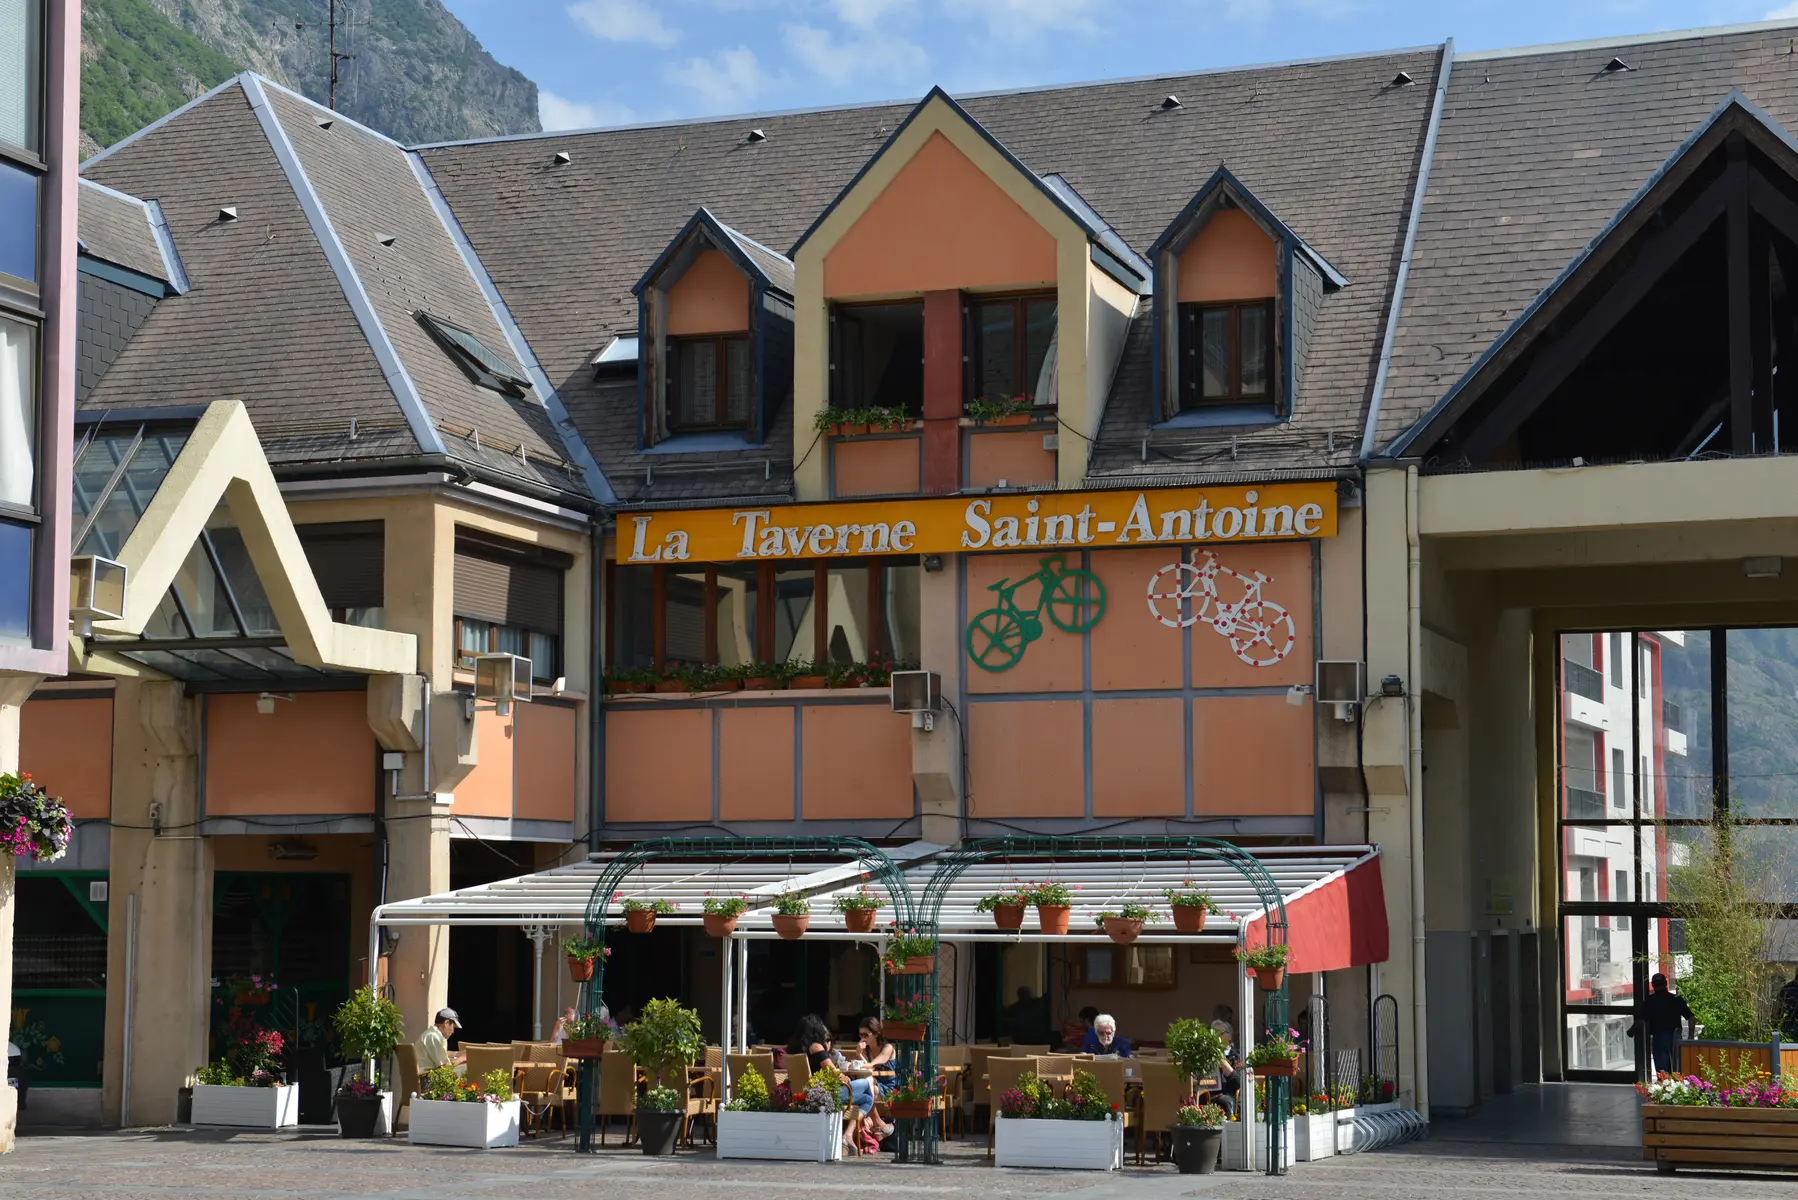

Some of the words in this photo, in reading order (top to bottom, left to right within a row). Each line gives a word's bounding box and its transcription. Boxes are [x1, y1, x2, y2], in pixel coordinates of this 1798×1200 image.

[627, 516, 691, 562] La
[731, 511, 916, 557] Taverne
[961, 490, 1323, 549] Saint-Antoine
